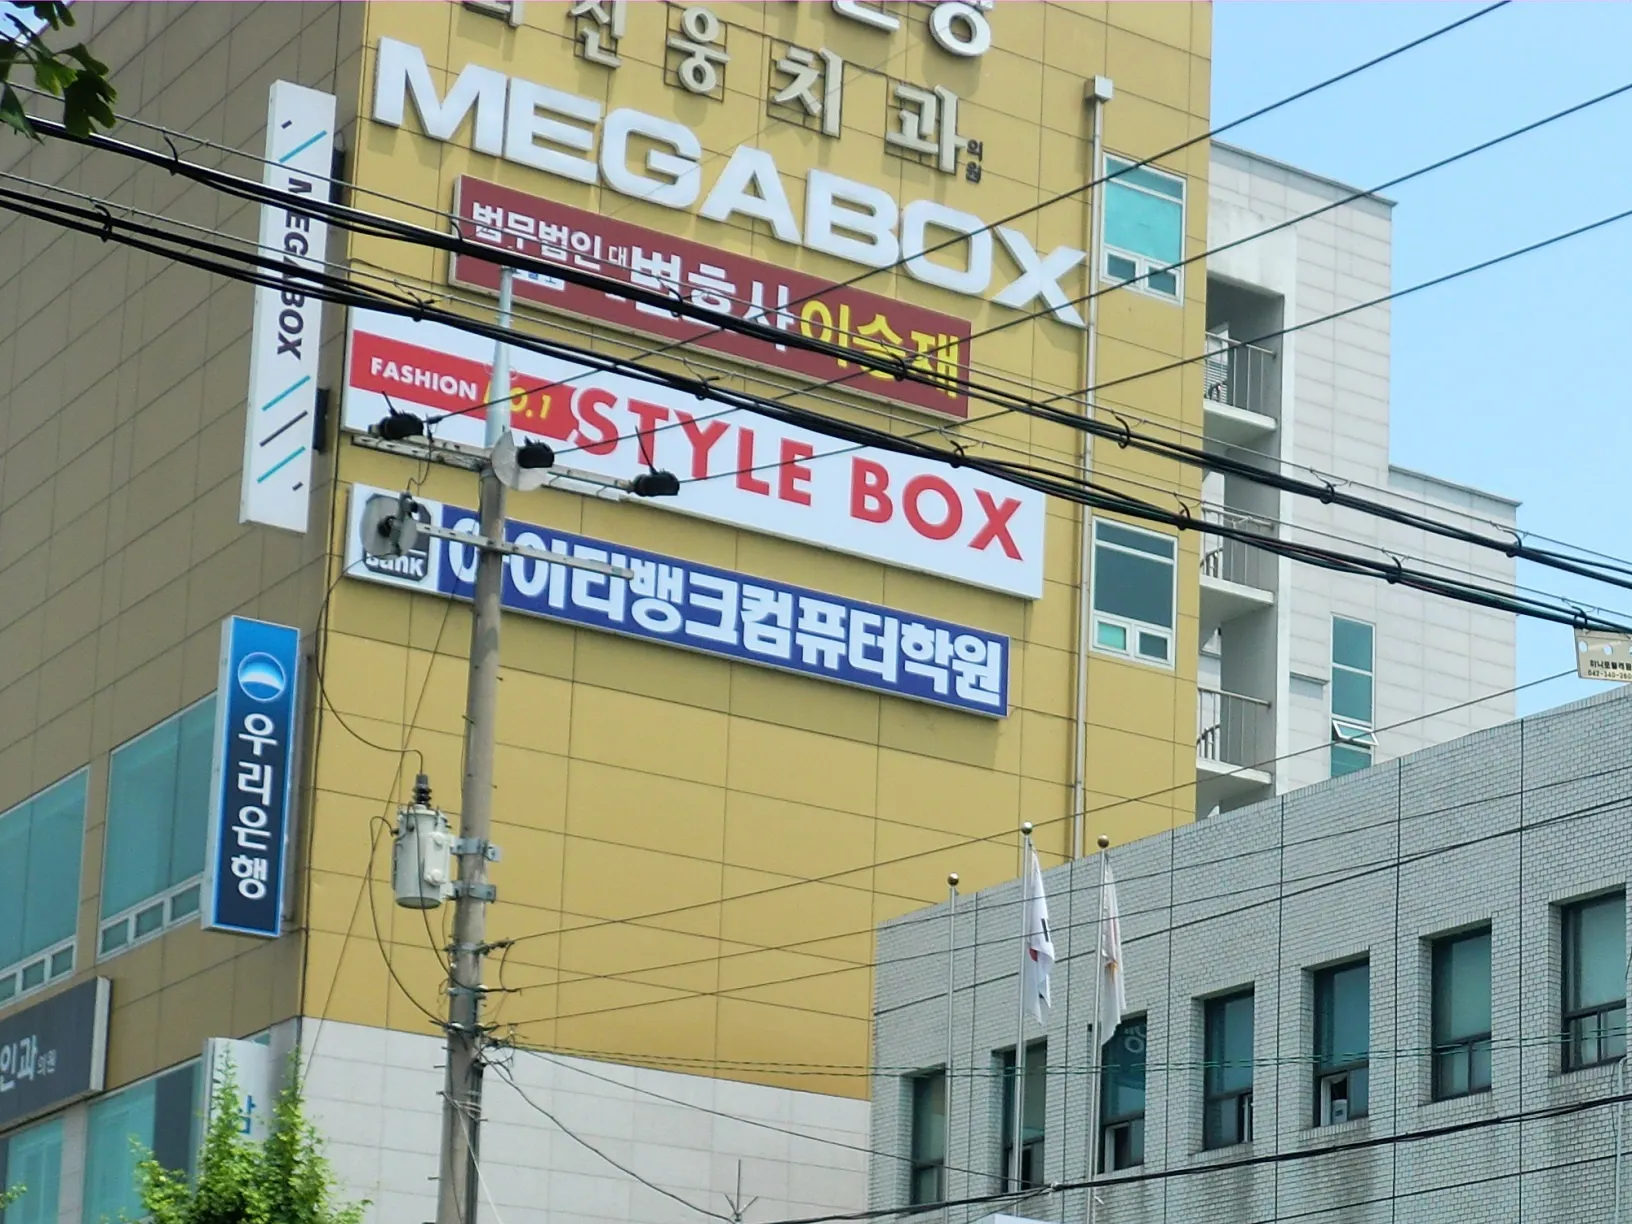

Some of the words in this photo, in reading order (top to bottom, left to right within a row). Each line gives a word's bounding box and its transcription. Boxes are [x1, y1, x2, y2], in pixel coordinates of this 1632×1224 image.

[374, 36, 1086, 326] MEGABOX
[370, 356, 478, 402] FASHION
[483, 379, 553, 420] O.1
[472, 201, 602, 272] 법무법인
[800, 299, 959, 399] 이승재
[577, 386, 814, 507] STYLE
[849, 455, 1025, 562] BOX
[450, 517, 1002, 708] 아이티뱅크컴퓨터학원
[230, 713, 278, 900] 우리은행
